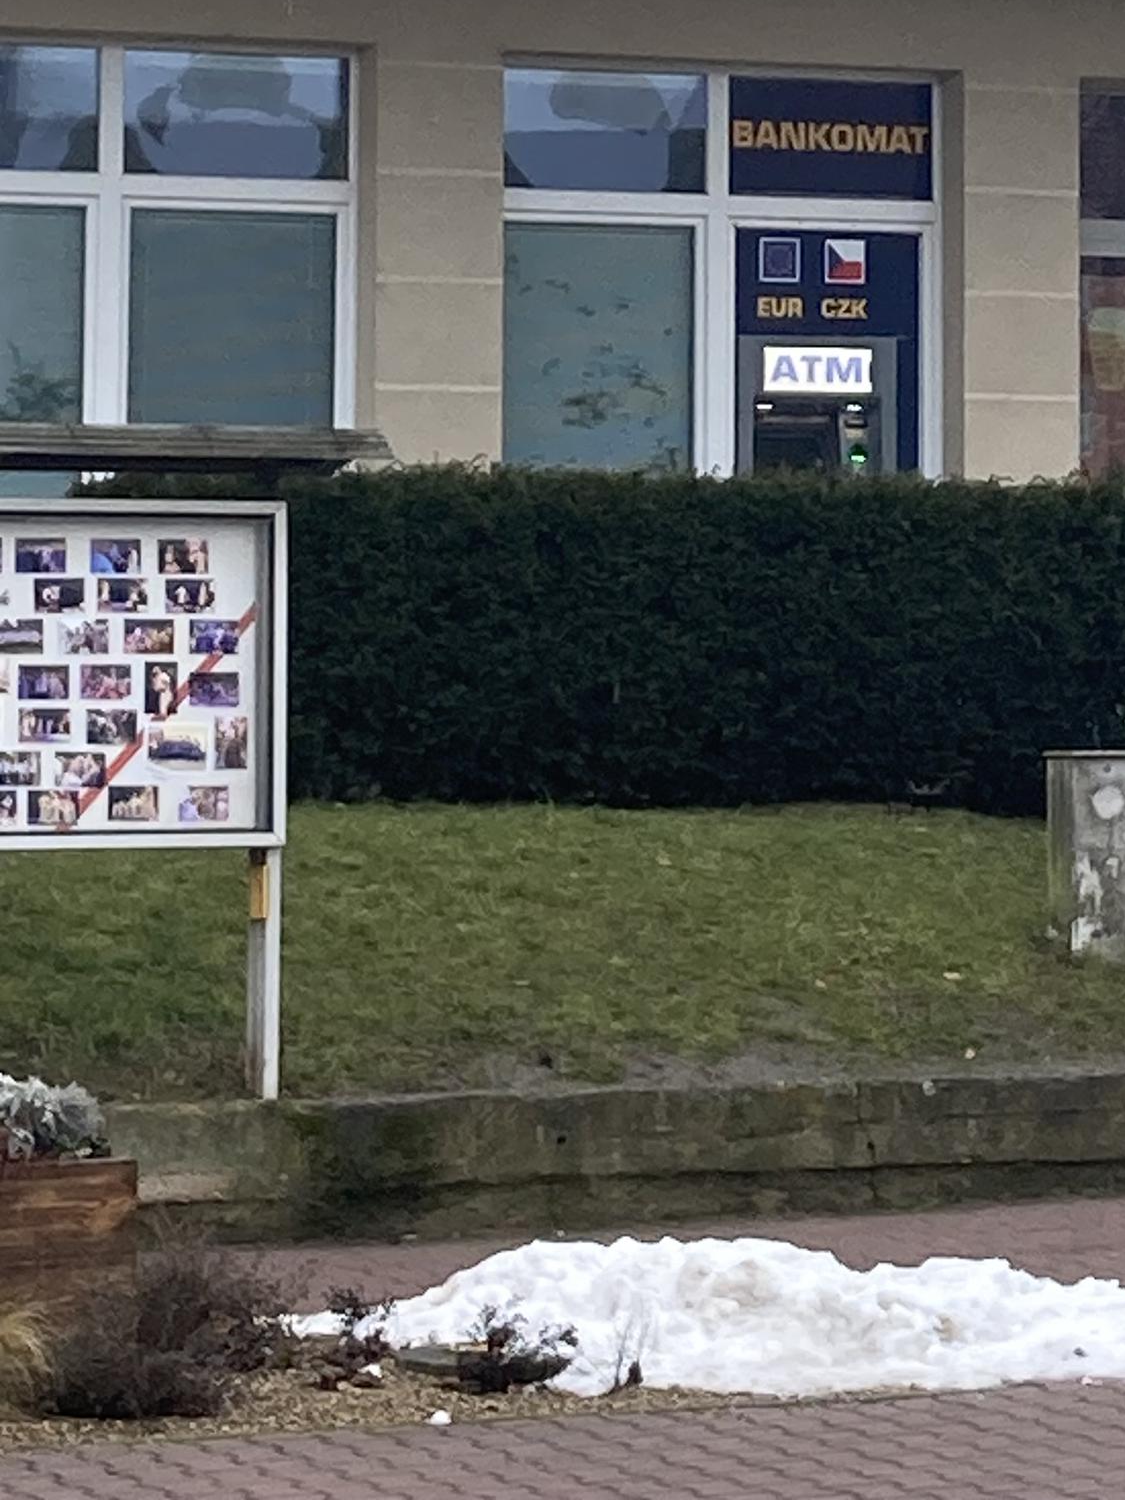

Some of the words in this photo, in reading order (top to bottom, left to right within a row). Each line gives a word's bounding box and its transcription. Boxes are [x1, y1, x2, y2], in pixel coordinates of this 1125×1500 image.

[733, 120, 928, 154] BANKOMAT
[758, 297, 804, 318] EUR
[820, 298, 868, 320] CZK
[770, 356, 863, 383] ATM
